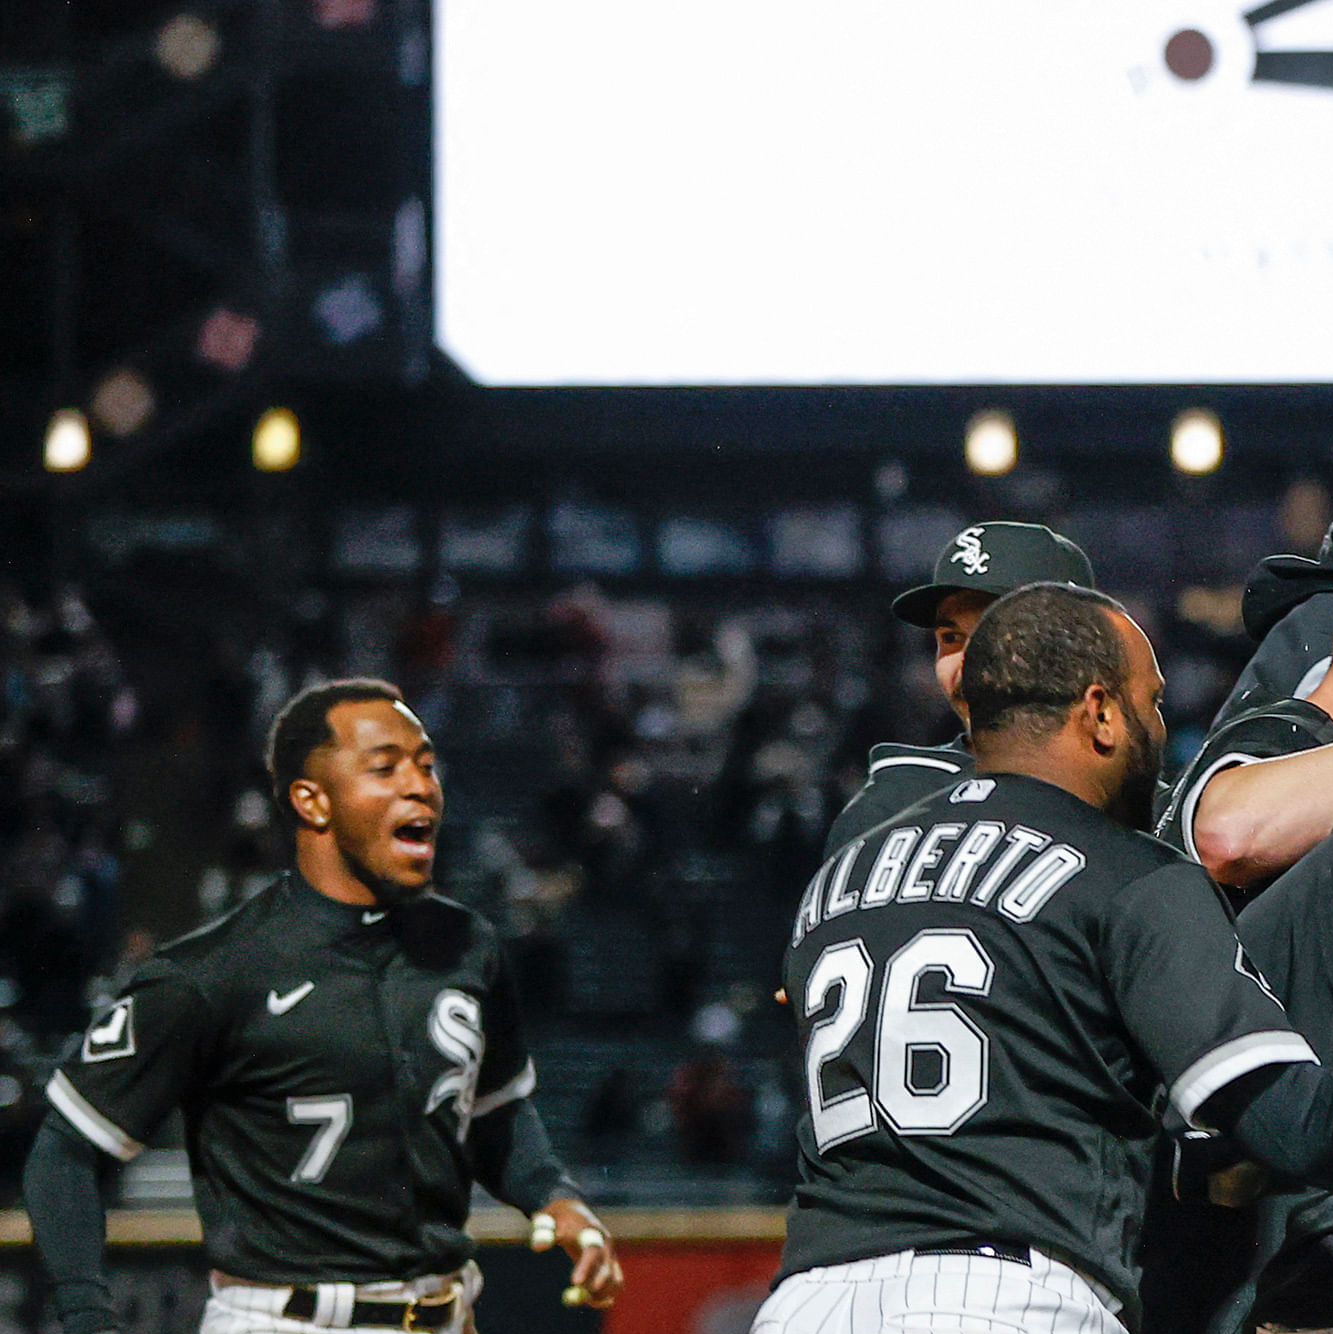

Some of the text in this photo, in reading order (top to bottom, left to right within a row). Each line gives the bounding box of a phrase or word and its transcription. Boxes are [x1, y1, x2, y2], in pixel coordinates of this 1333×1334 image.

[792, 820, 1086, 949] ALBERTO
[804, 927, 997, 1155] 26
[286, 1092, 354, 1185] 7
